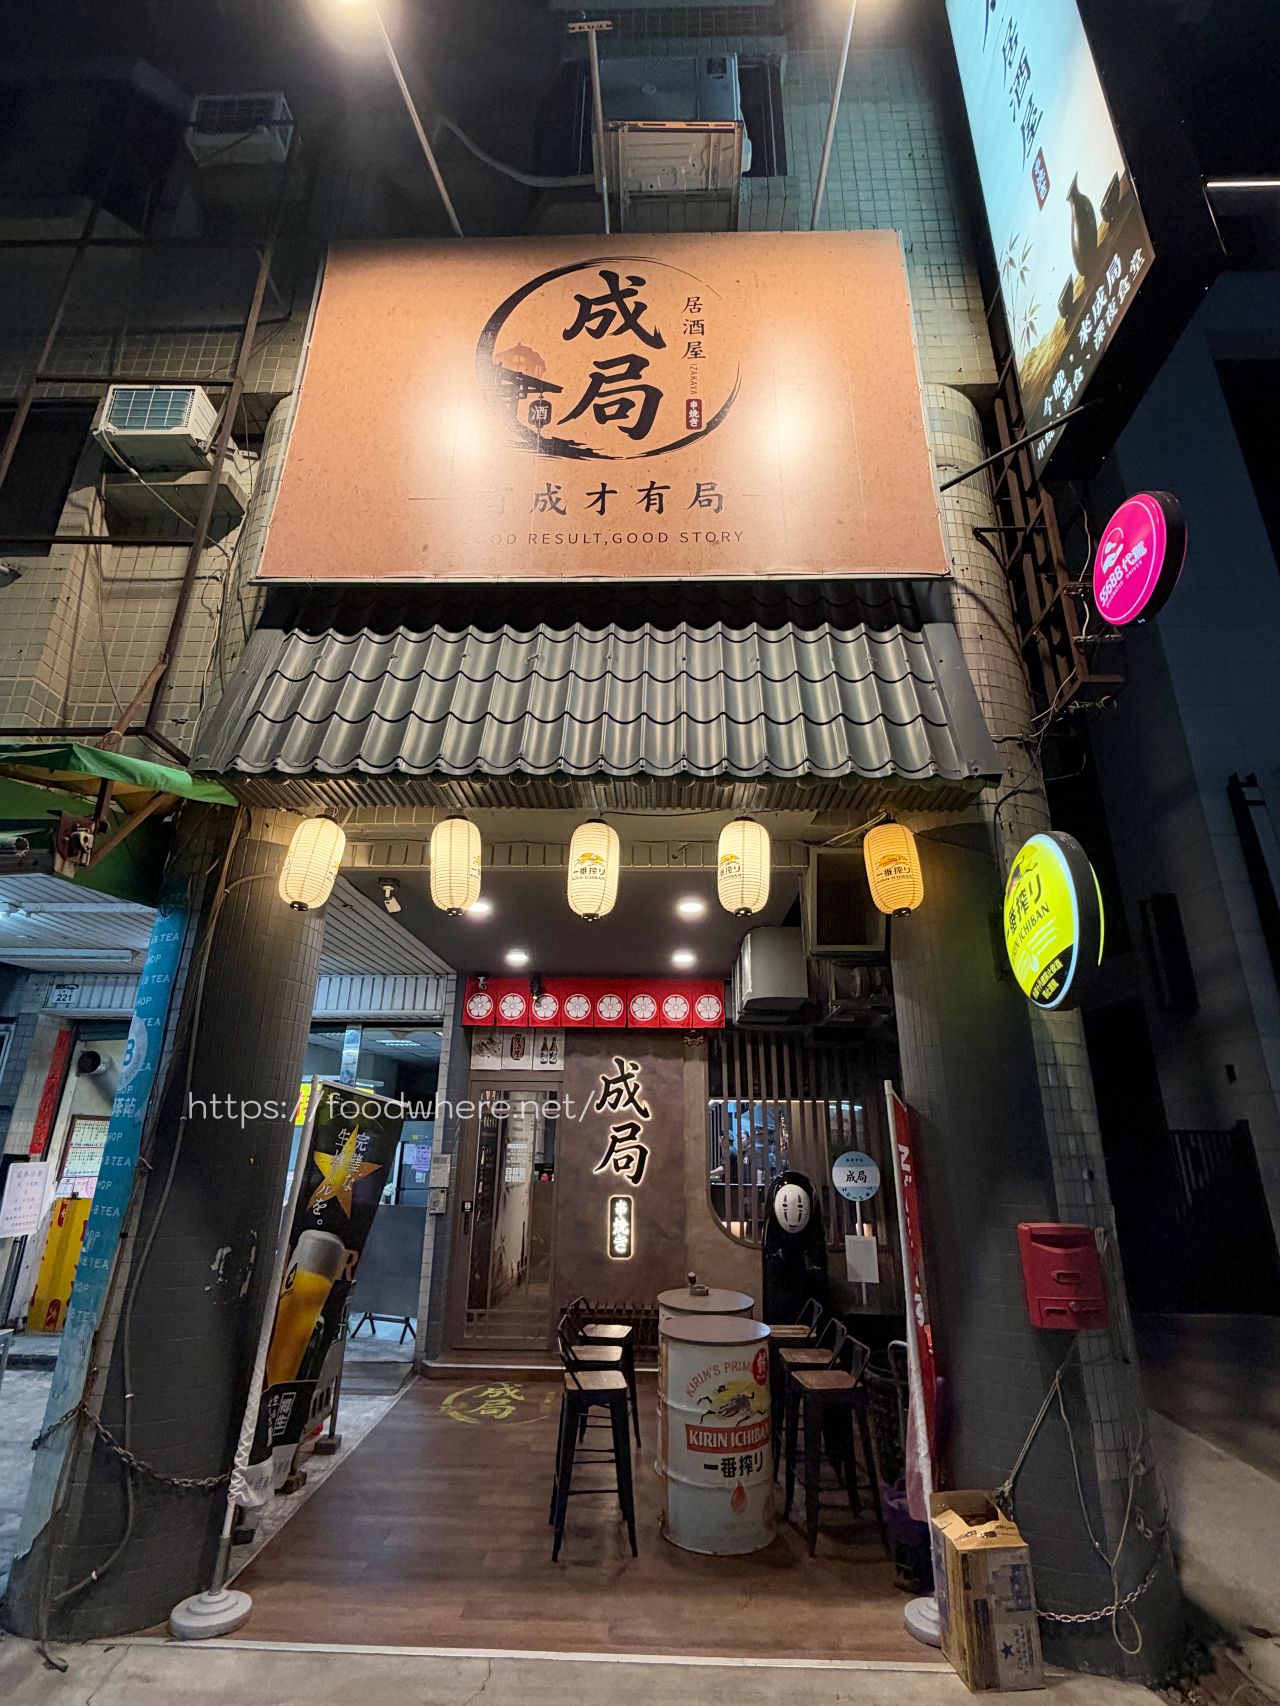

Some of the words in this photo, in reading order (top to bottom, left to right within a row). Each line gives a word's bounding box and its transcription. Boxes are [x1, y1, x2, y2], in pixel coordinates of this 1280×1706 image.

[1003, 16, 1043, 172] 居酒屋
[682, 296, 706, 360] 居酒屋
[557, 270, 666, 440] 成局
[689, 363, 697, 395] IZAKAYA
[531, 404, 548, 421] 酒
[487, 482, 724, 516] 成才有局
[680, 531, 743, 543] STORY
[160, 933, 179, 943] TEA
[151, 975, 170, 983] TEA
[56, 993, 72, 1001] 221
[593, 1057, 651, 1185] 成局
[111, 1156, 131, 1168] TEA
[846, 1170, 867, 1184] 成局
[100, 1206, 120, 1217] TEA
[89, 1257, 109, 1270] TEA
[686, 1364, 720, 1398] KIRIN'S
[724, 1360, 752, 1374] PRIM
[466, 1383, 525, 1420] 成局
[689, 1429, 728, 1448] KIRIN
[731, 1422, 769, 1448] ICHIBAN
[703, 1450, 764, 1478] 一番搾り
